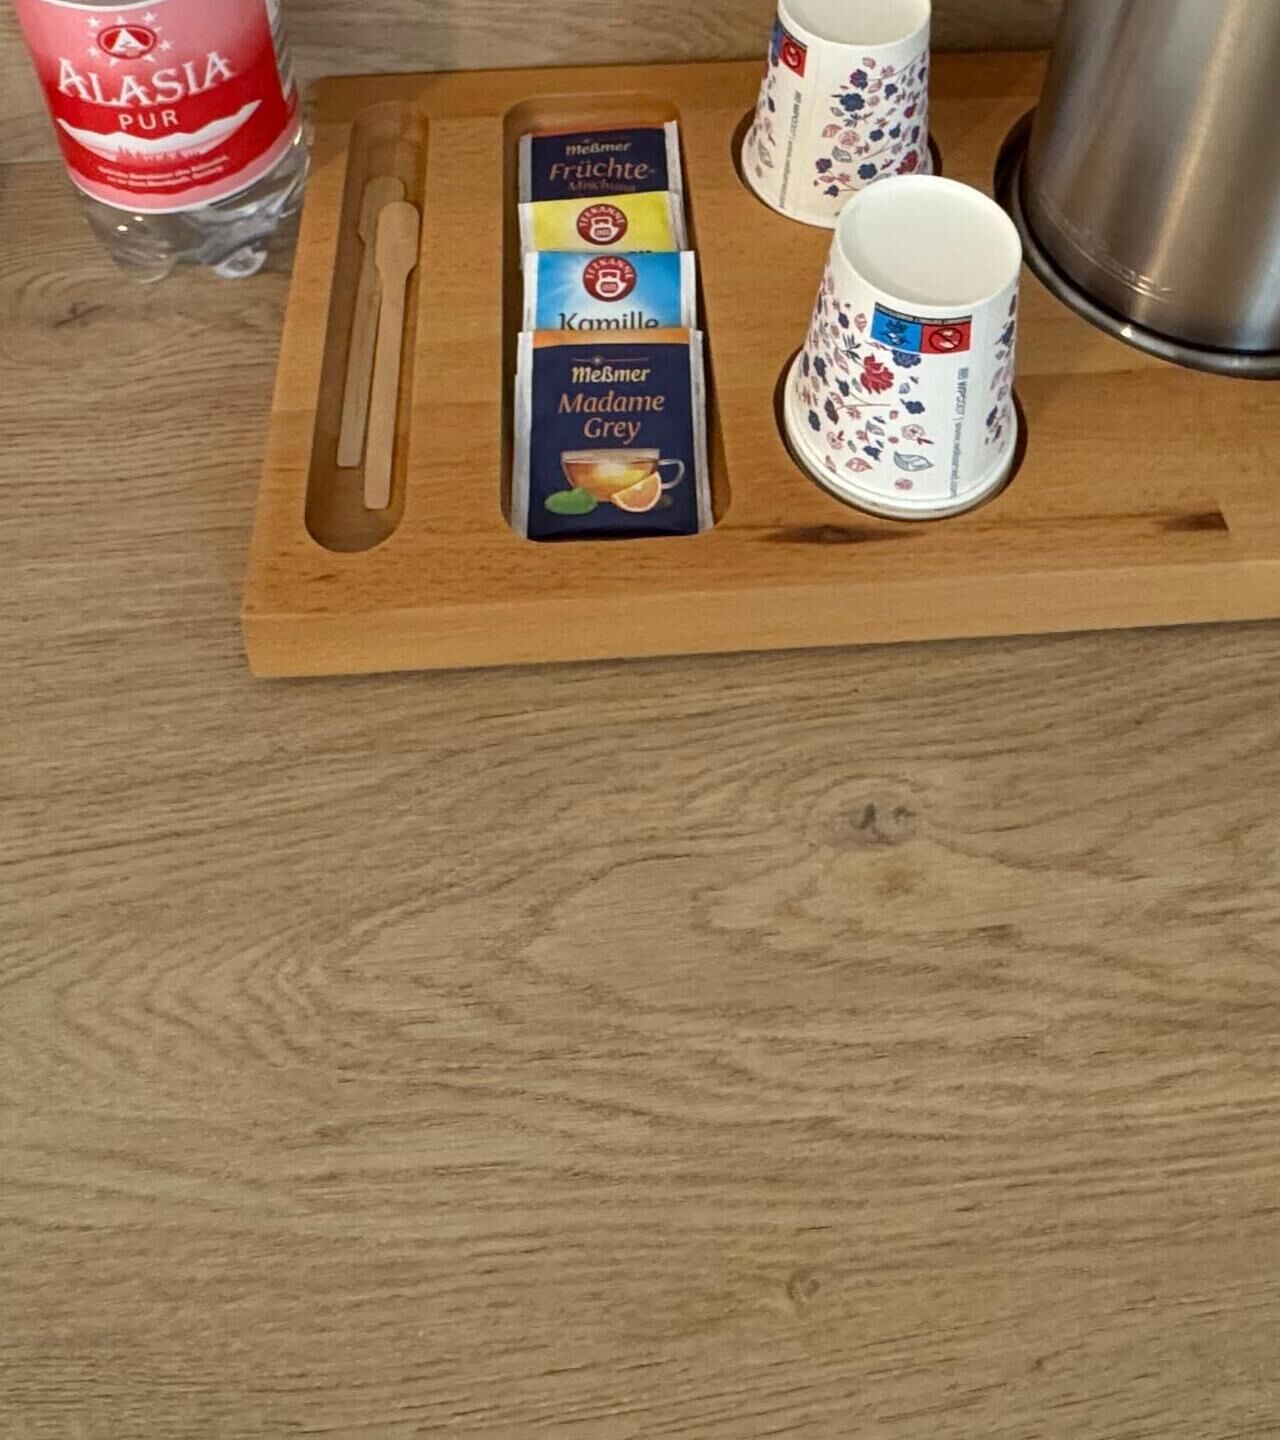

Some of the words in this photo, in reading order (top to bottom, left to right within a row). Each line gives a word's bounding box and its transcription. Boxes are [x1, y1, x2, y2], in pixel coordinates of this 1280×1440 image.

[57, 51, 237, 107] ALASIA
[118, 110, 179, 130] PUR
[565, 142, 632, 157] Meßmer
[548, 157, 658, 181] Früchte-
[559, 311, 659, 330] Kamille
[571, 365, 651, 384] Meßmer
[557, 390, 665, 414] Madame
[583, 417, 641, 445] Grey
